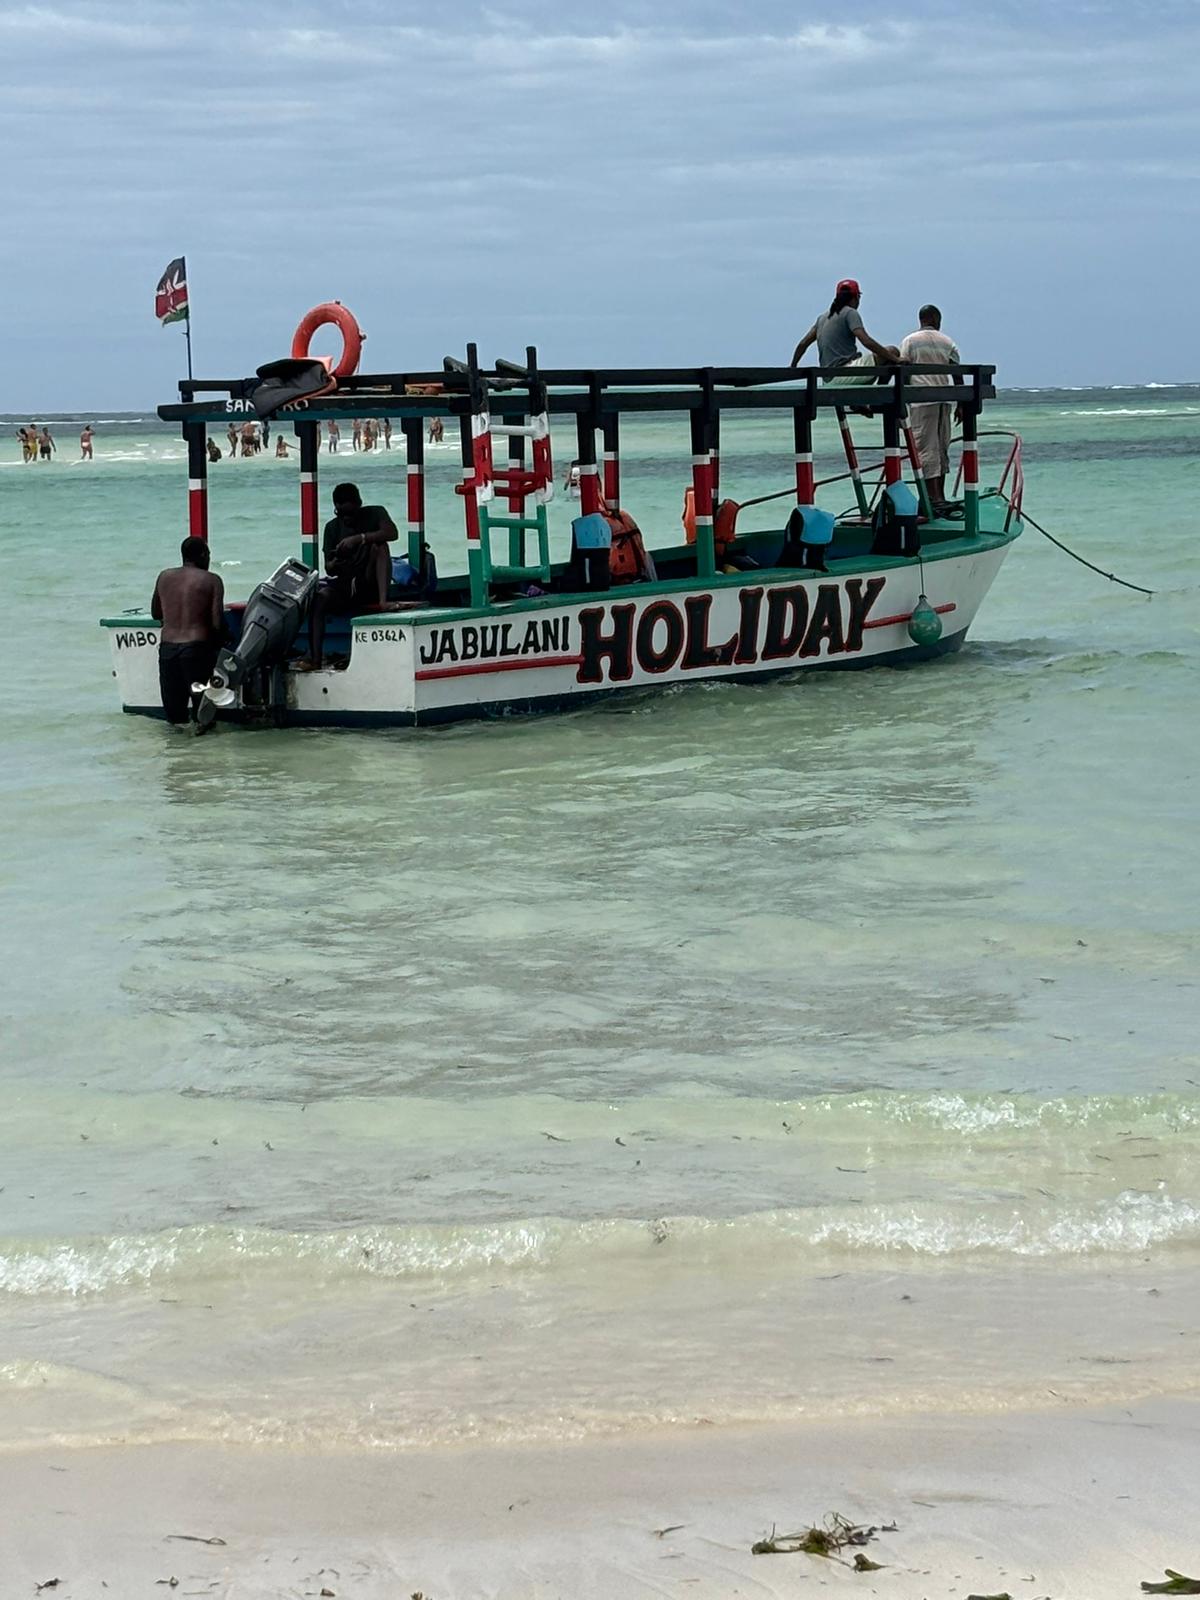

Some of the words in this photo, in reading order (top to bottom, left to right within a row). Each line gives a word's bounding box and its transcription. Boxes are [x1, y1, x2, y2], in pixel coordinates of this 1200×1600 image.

[355, 631, 368, 643] KE
[371, 629, 407, 642] 0362A
[420, 616, 570, 664] JABULANI
[576, 577, 886, 683] HOLIDAY
